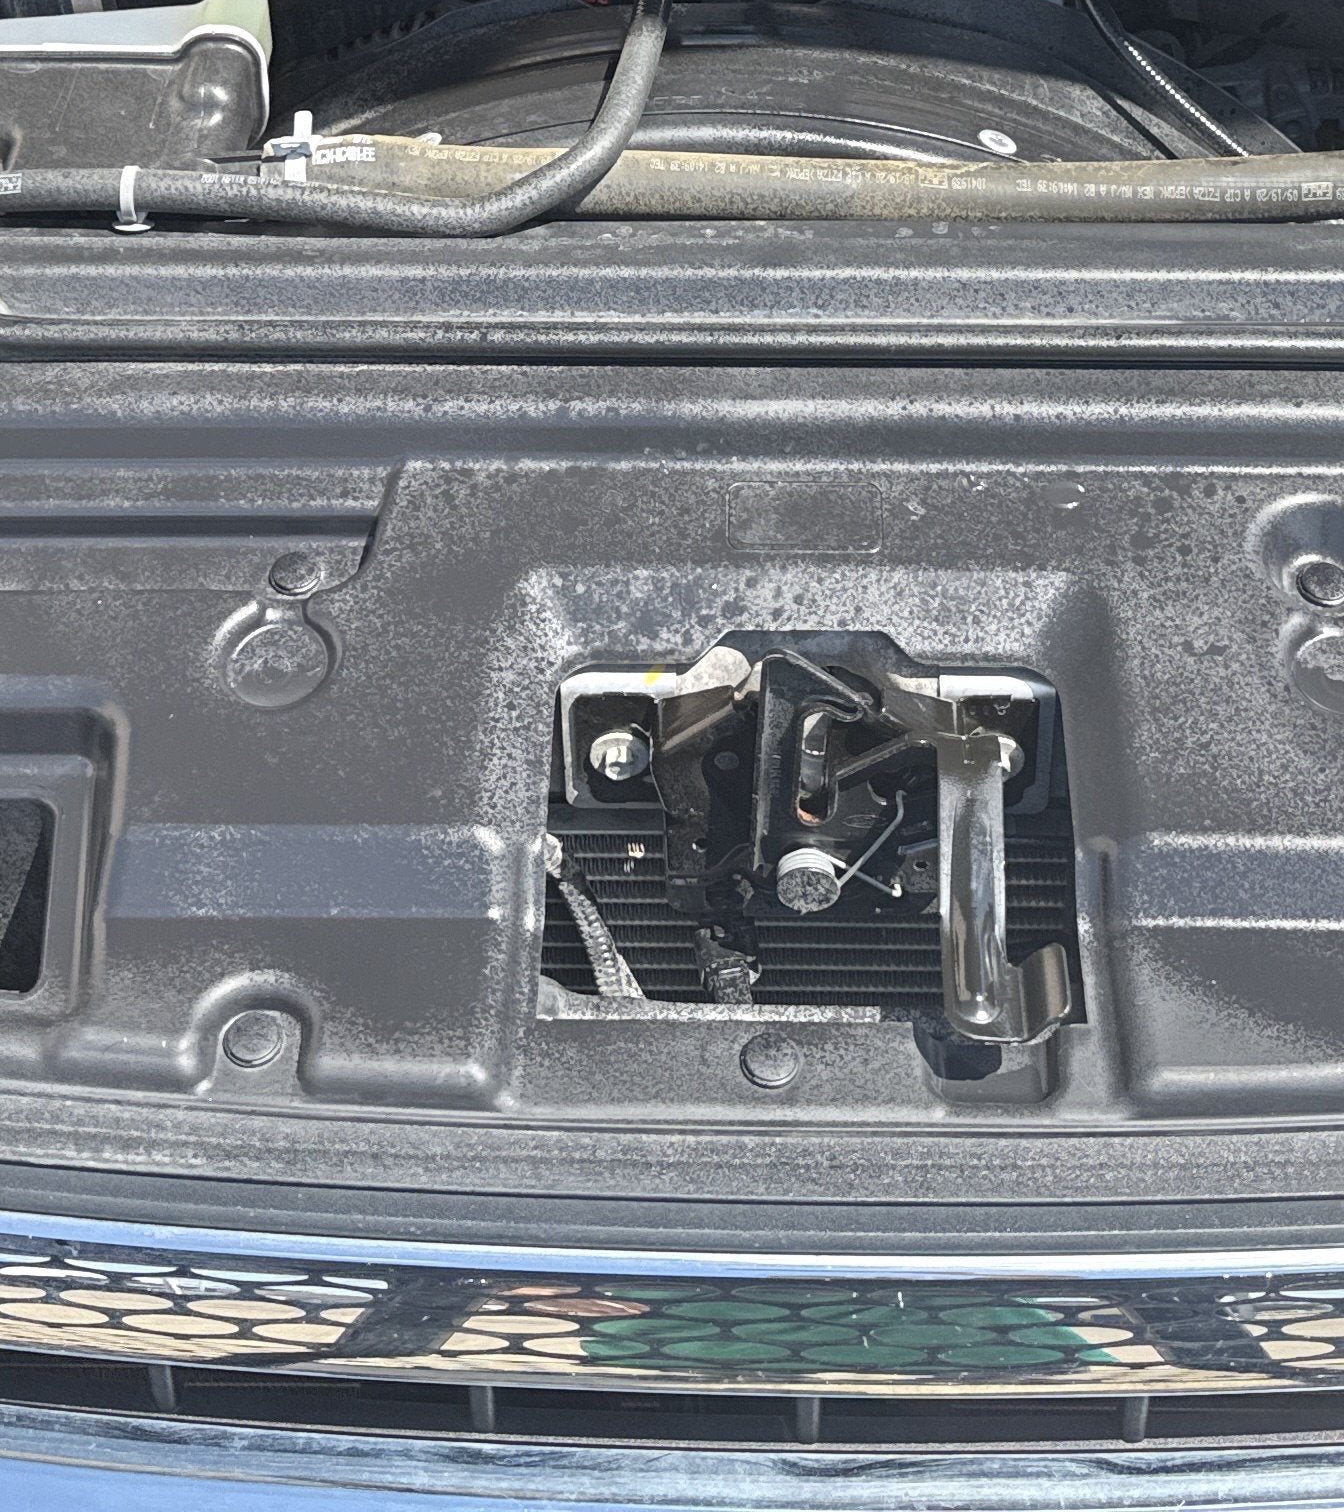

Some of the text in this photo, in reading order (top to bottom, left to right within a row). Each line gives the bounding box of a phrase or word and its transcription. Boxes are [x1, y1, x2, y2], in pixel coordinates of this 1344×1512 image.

[649, 158, 666, 170] TEC
[1016, 179, 1032, 192] TEC
[1224, 188, 1241, 202] CIP
[1244, 189, 1251, 201] A
[1256, 188, 1299, 202] 09/19/20
